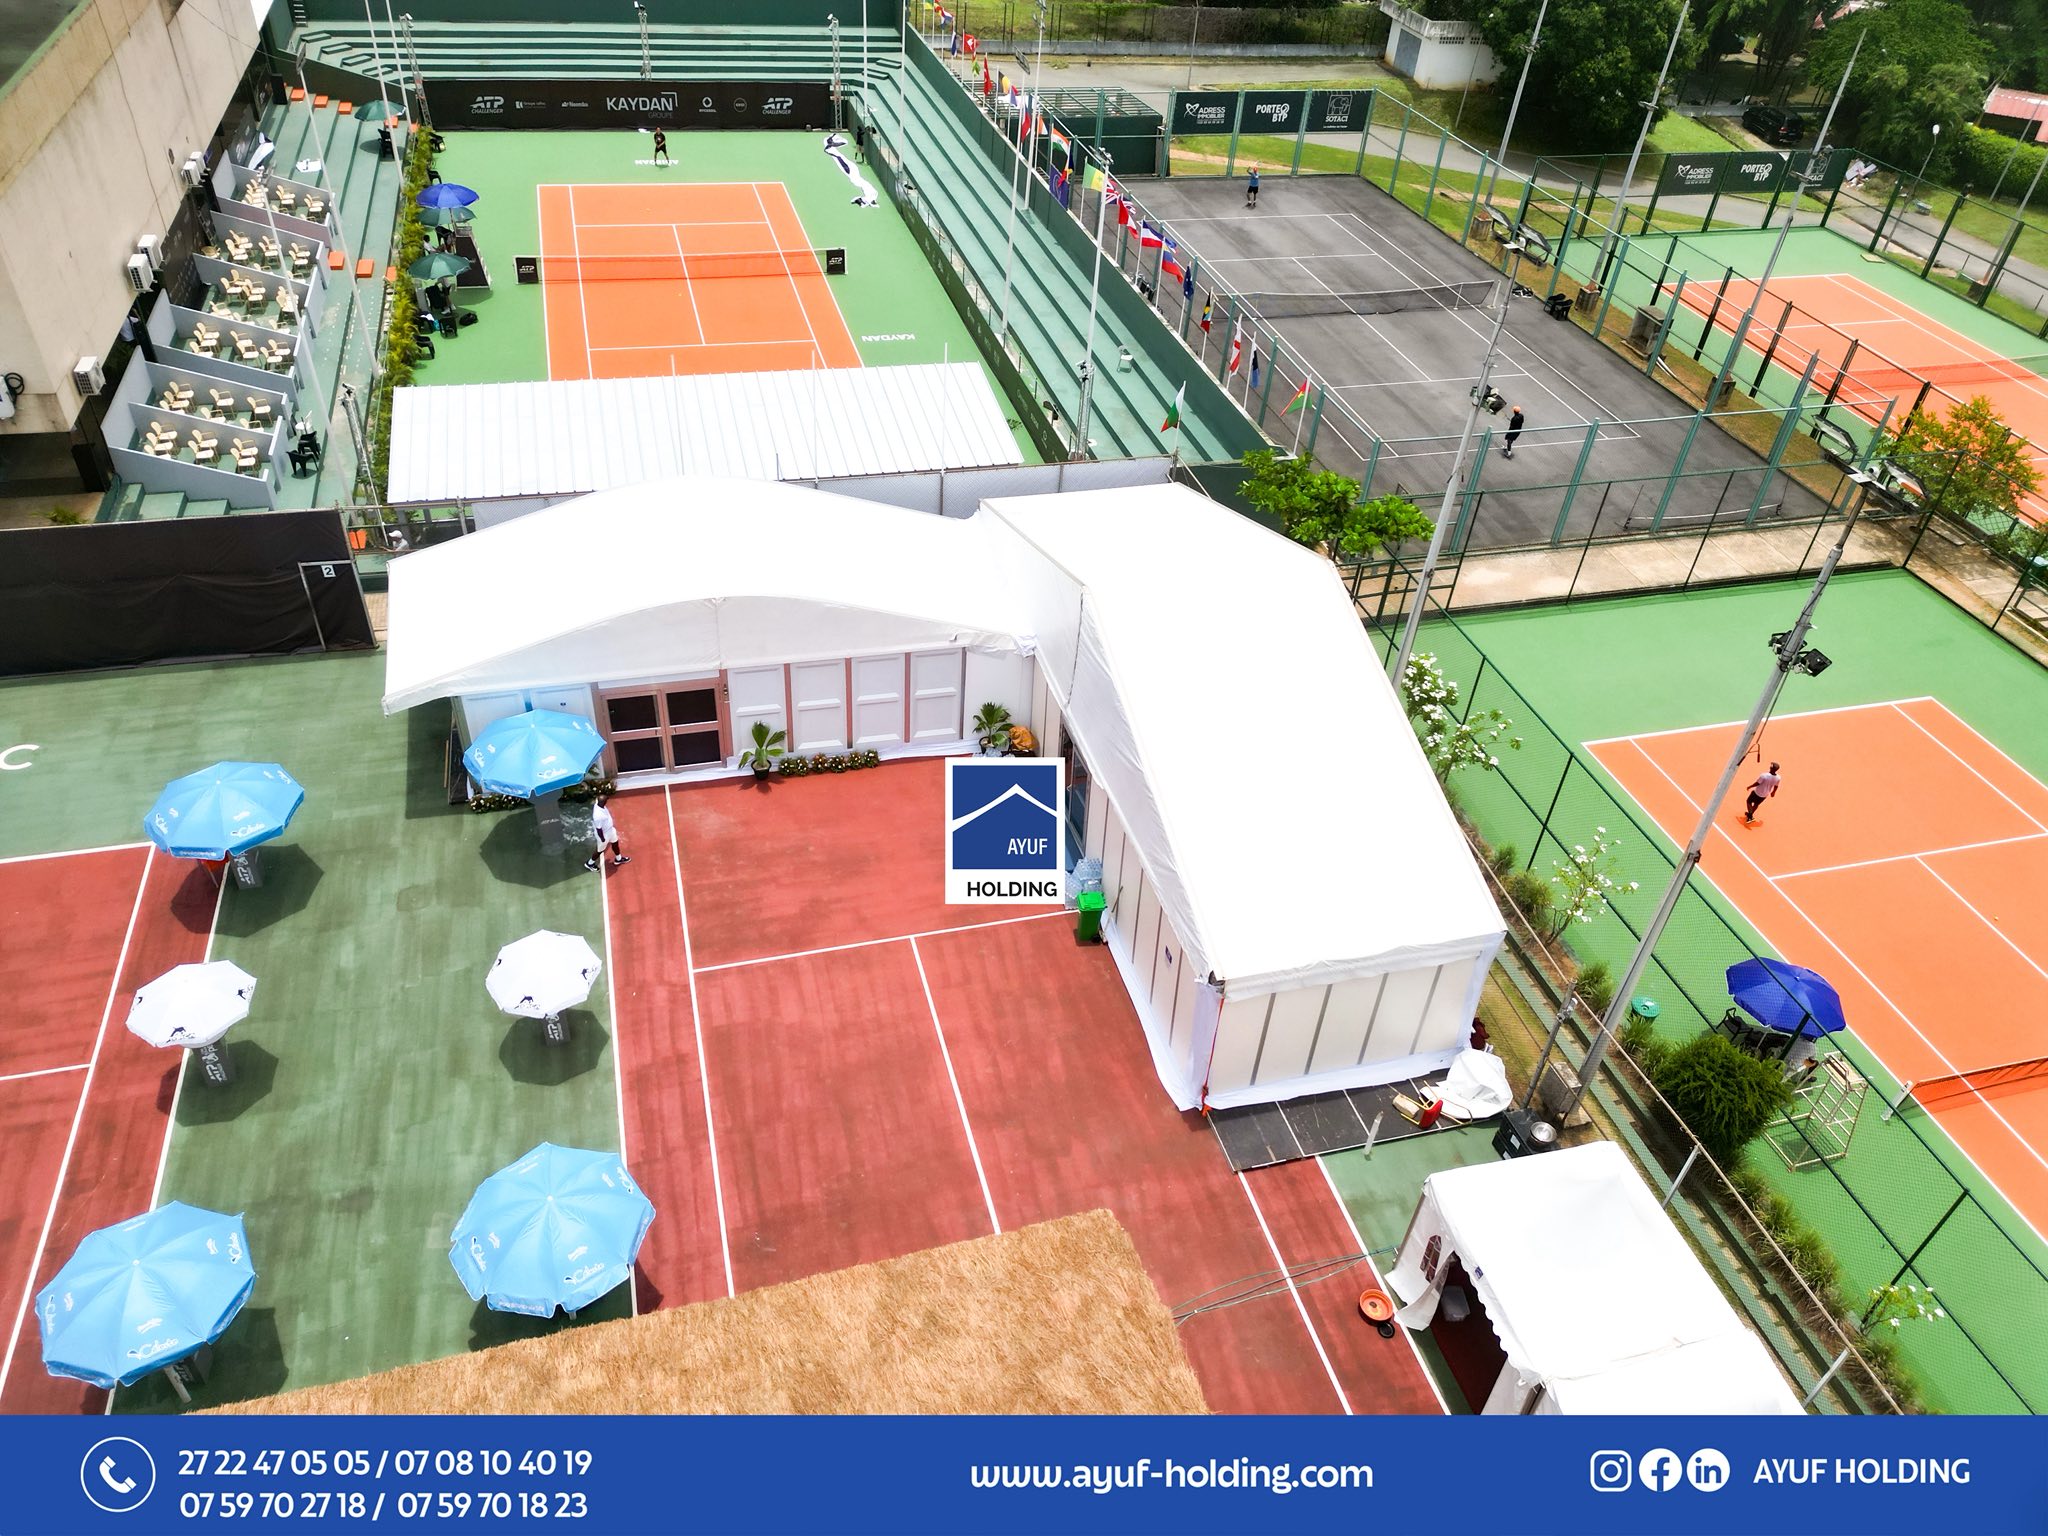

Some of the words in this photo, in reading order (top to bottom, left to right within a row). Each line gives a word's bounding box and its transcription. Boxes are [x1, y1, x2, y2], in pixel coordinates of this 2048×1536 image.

[470, 96, 505, 109] ATP
[606, 97, 674, 111] KAYDAN
[762, 97, 794, 109] ATP
[1198, 106, 1226, 114] ADRESS
[1272, 113, 1288, 122] BTP
[1754, 172, 1769, 181] BTP
[861, 333, 916, 342] KAYDAN
[324, 566, 334, 576] 2
